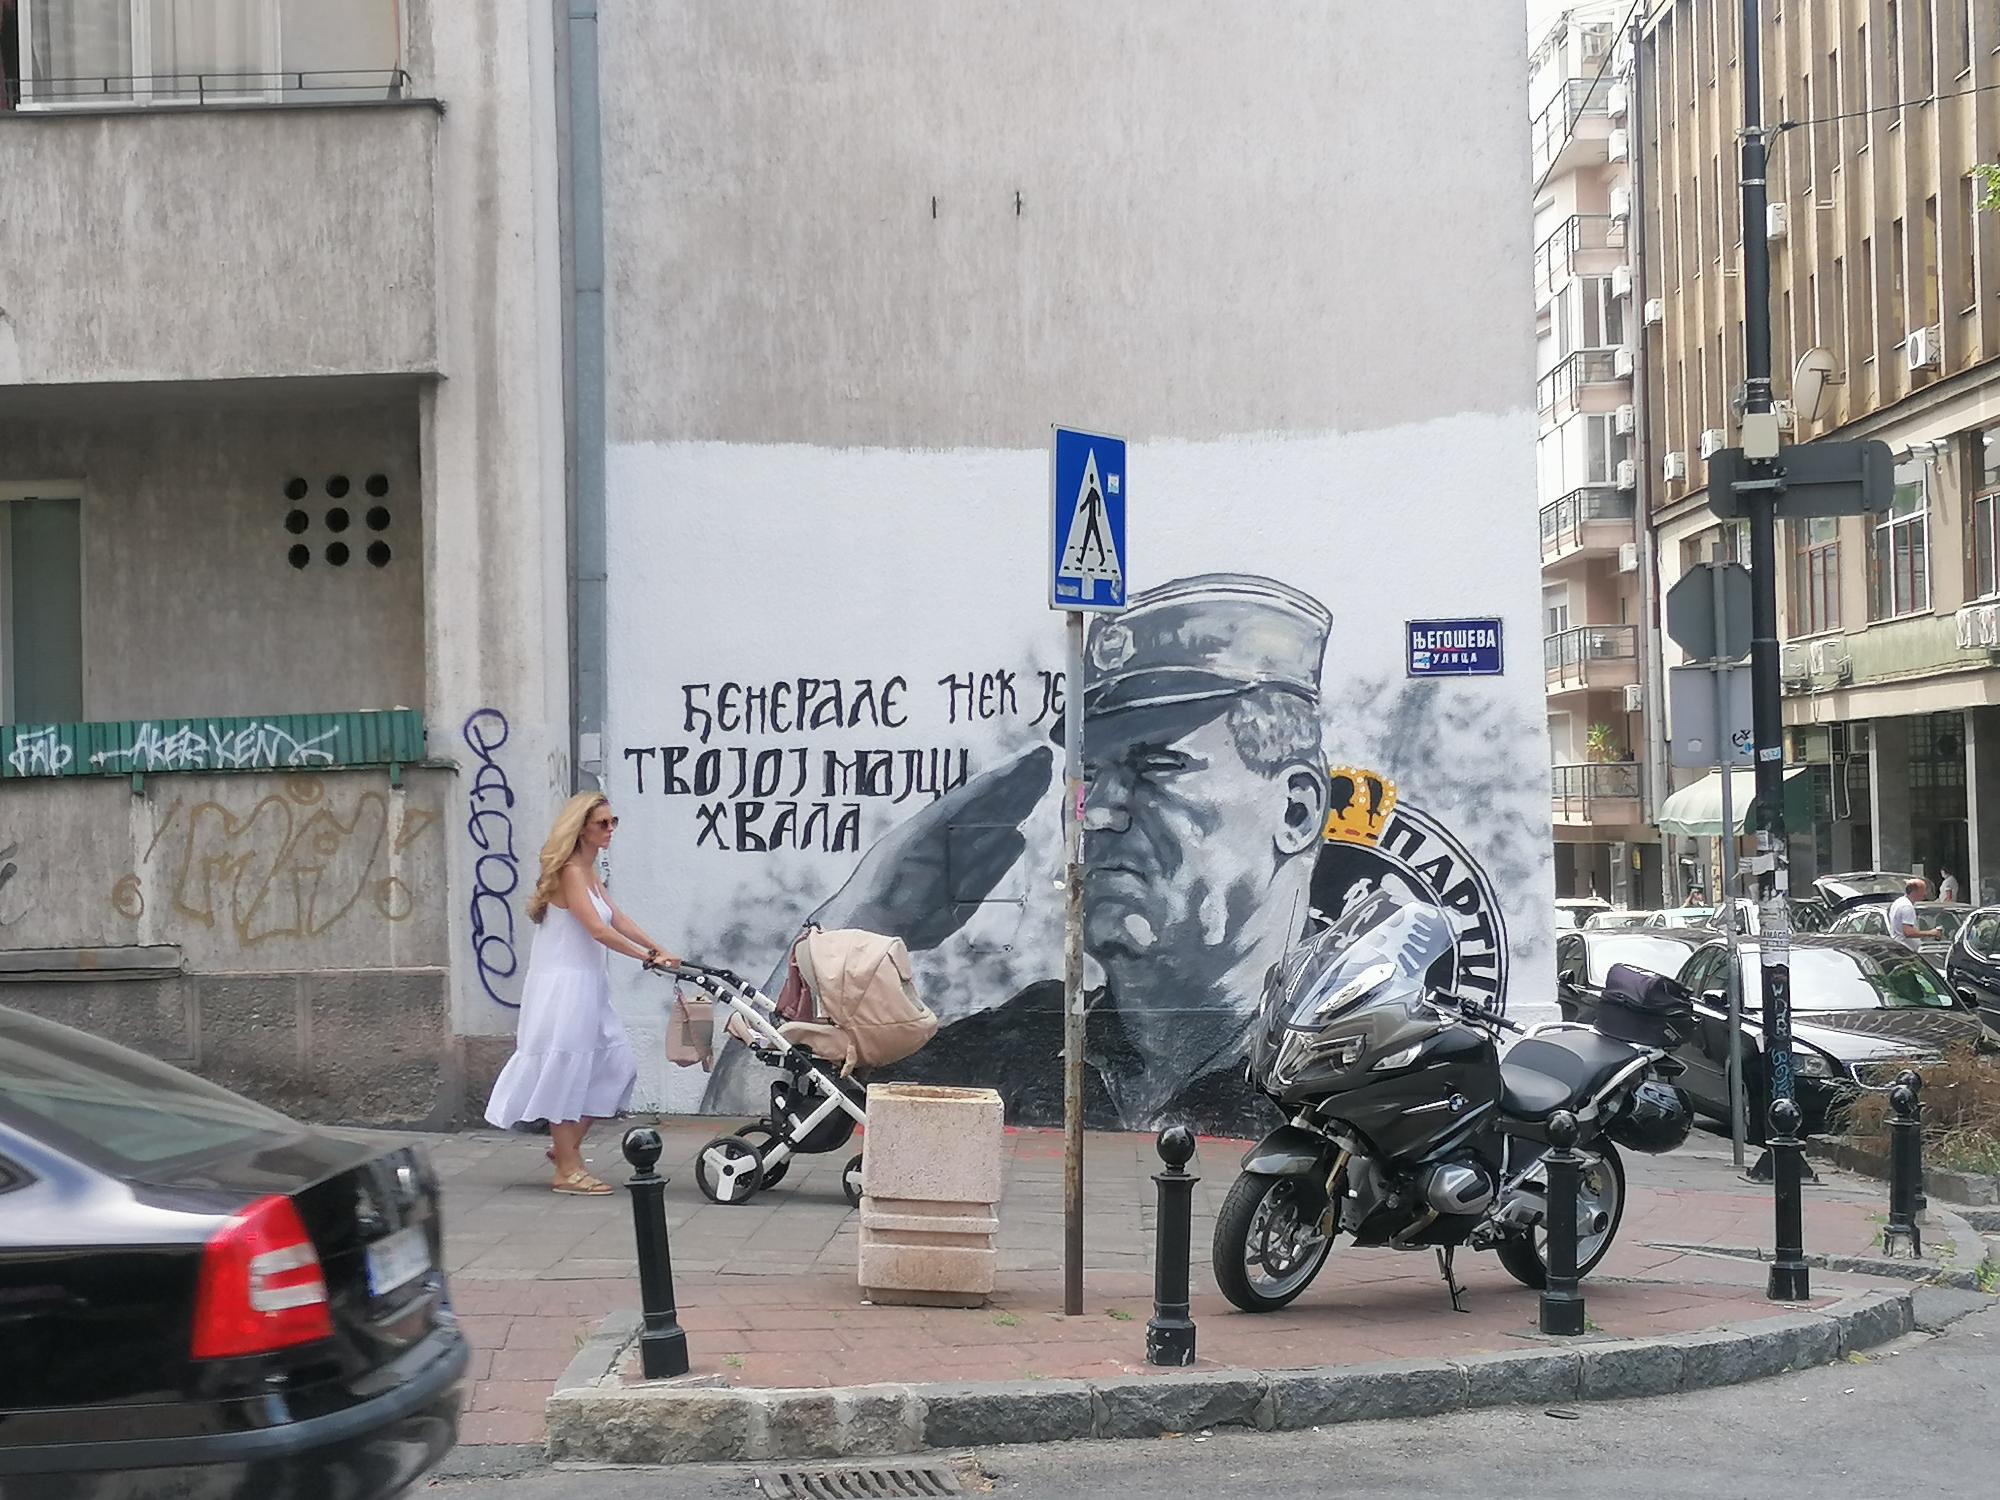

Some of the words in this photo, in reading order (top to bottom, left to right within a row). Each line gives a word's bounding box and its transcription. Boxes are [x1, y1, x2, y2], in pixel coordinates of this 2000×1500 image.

[1412, 629, 1496, 649] ЊЕГОШЕВА
[1432, 652, 1477, 664] УЛИЦА
[938, 669, 1018, 724] НЕК
[624, 746, 807, 798] ТВОЈОЈ
[822, 748, 968, 804] МАЈЦИ
[696, 801, 860, 853] ХВАЛА
[1380, 815, 1496, 1011] ПАРТИ
